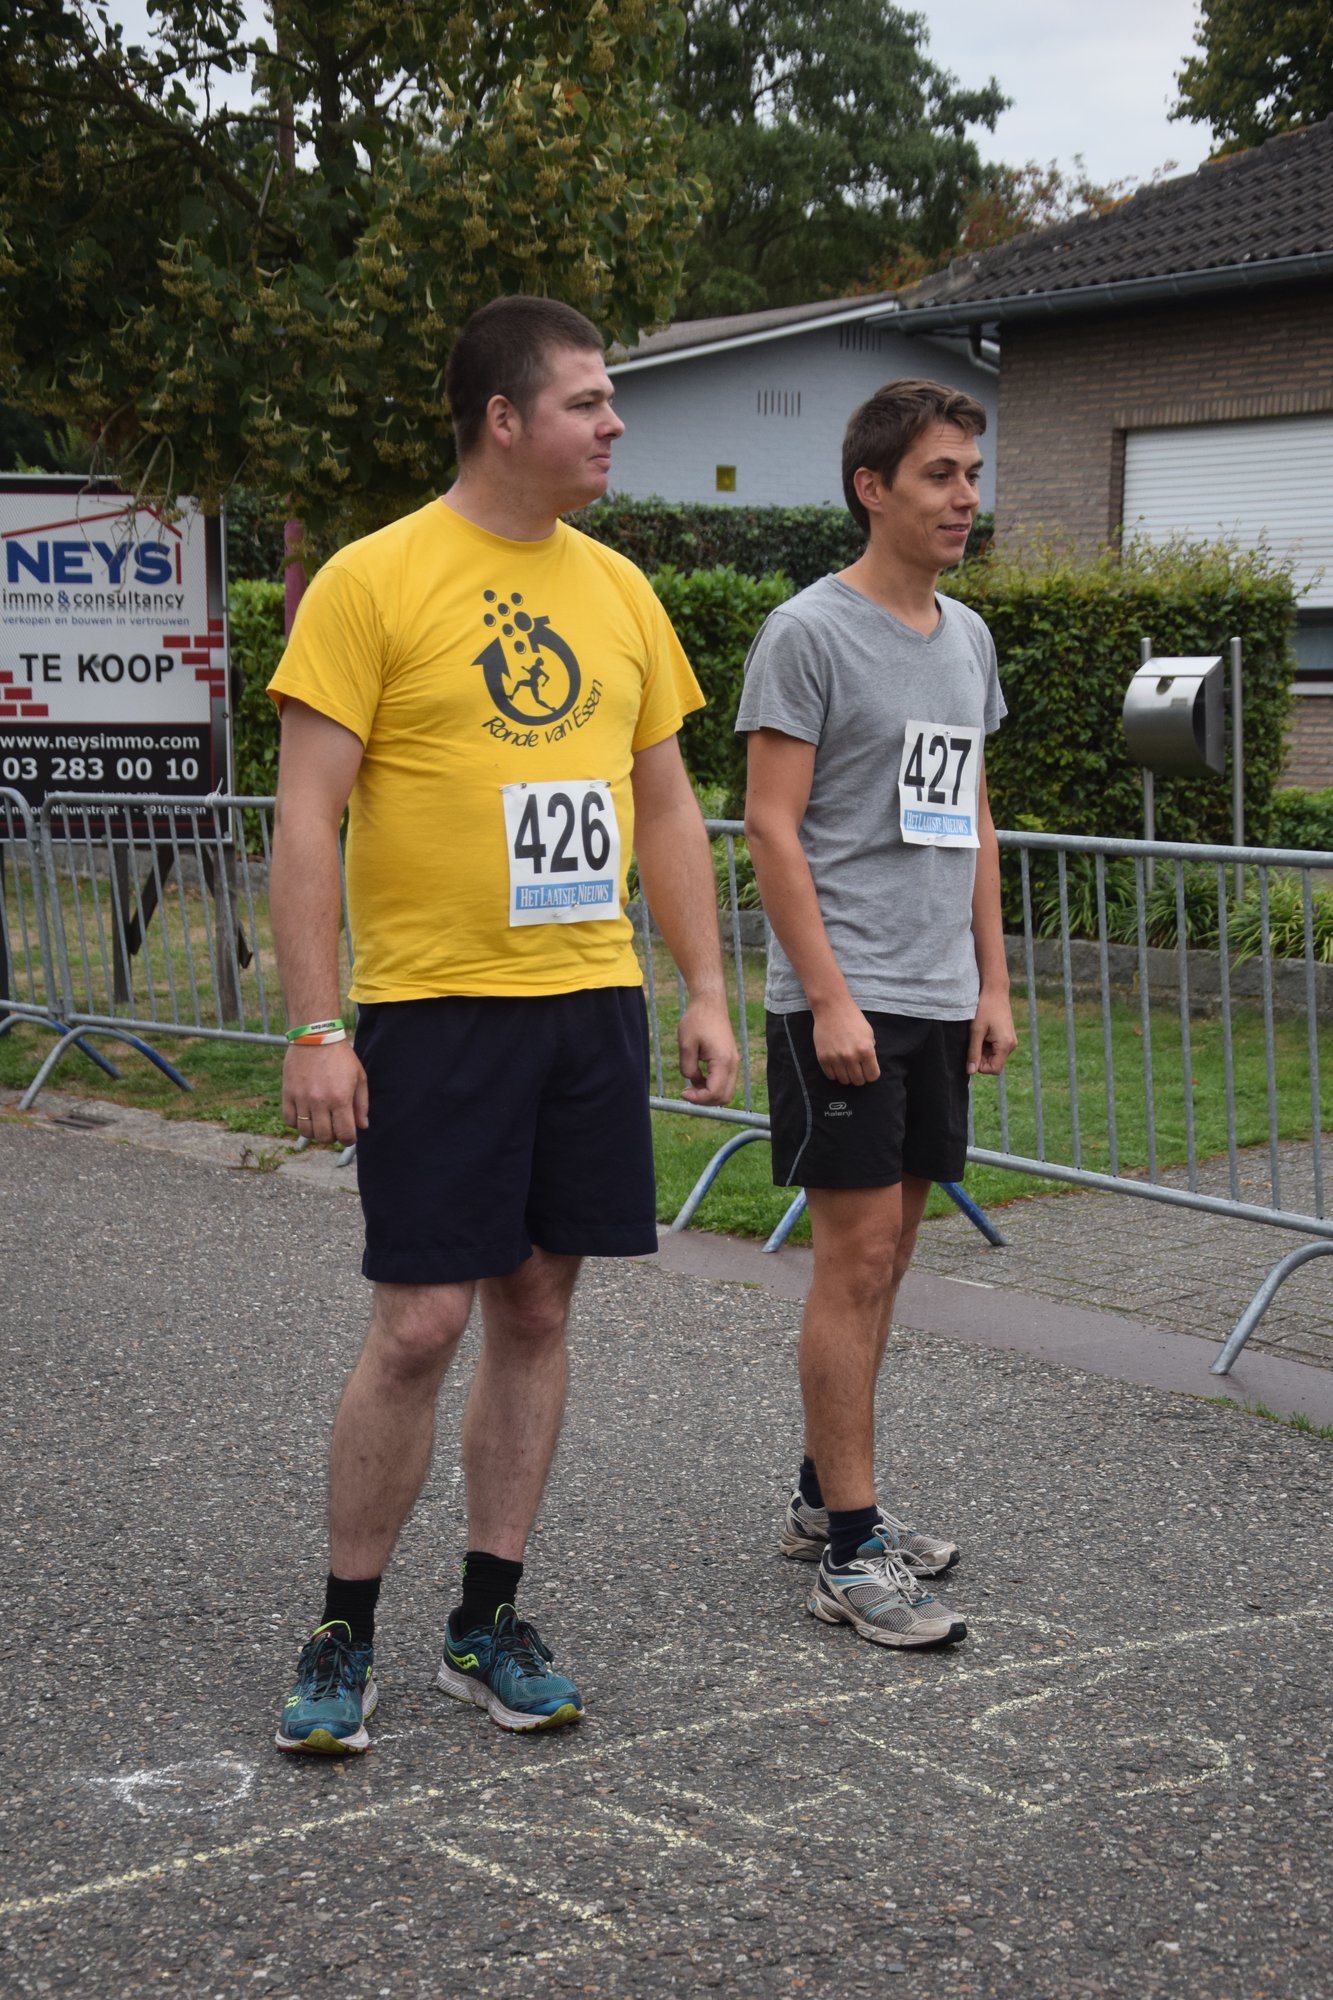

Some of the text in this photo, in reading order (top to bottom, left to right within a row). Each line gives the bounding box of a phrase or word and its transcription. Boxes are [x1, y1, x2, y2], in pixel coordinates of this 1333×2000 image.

[6, 541, 173, 585] NEYS
[2, 615, 190, 626] verkopen en bouwen in vertrouwen
[19, 653, 174, 683] TE KOOP
[481, 678, 604, 747] Ronde van Essen
[0, 733, 200, 752] www.neysimmo.com
[2, 757, 199, 781] 03 283 00 10
[903, 732, 973, 806] 427
[514, 791, 611, 874] 426
[577, 884, 609, 904] NIEUWS
